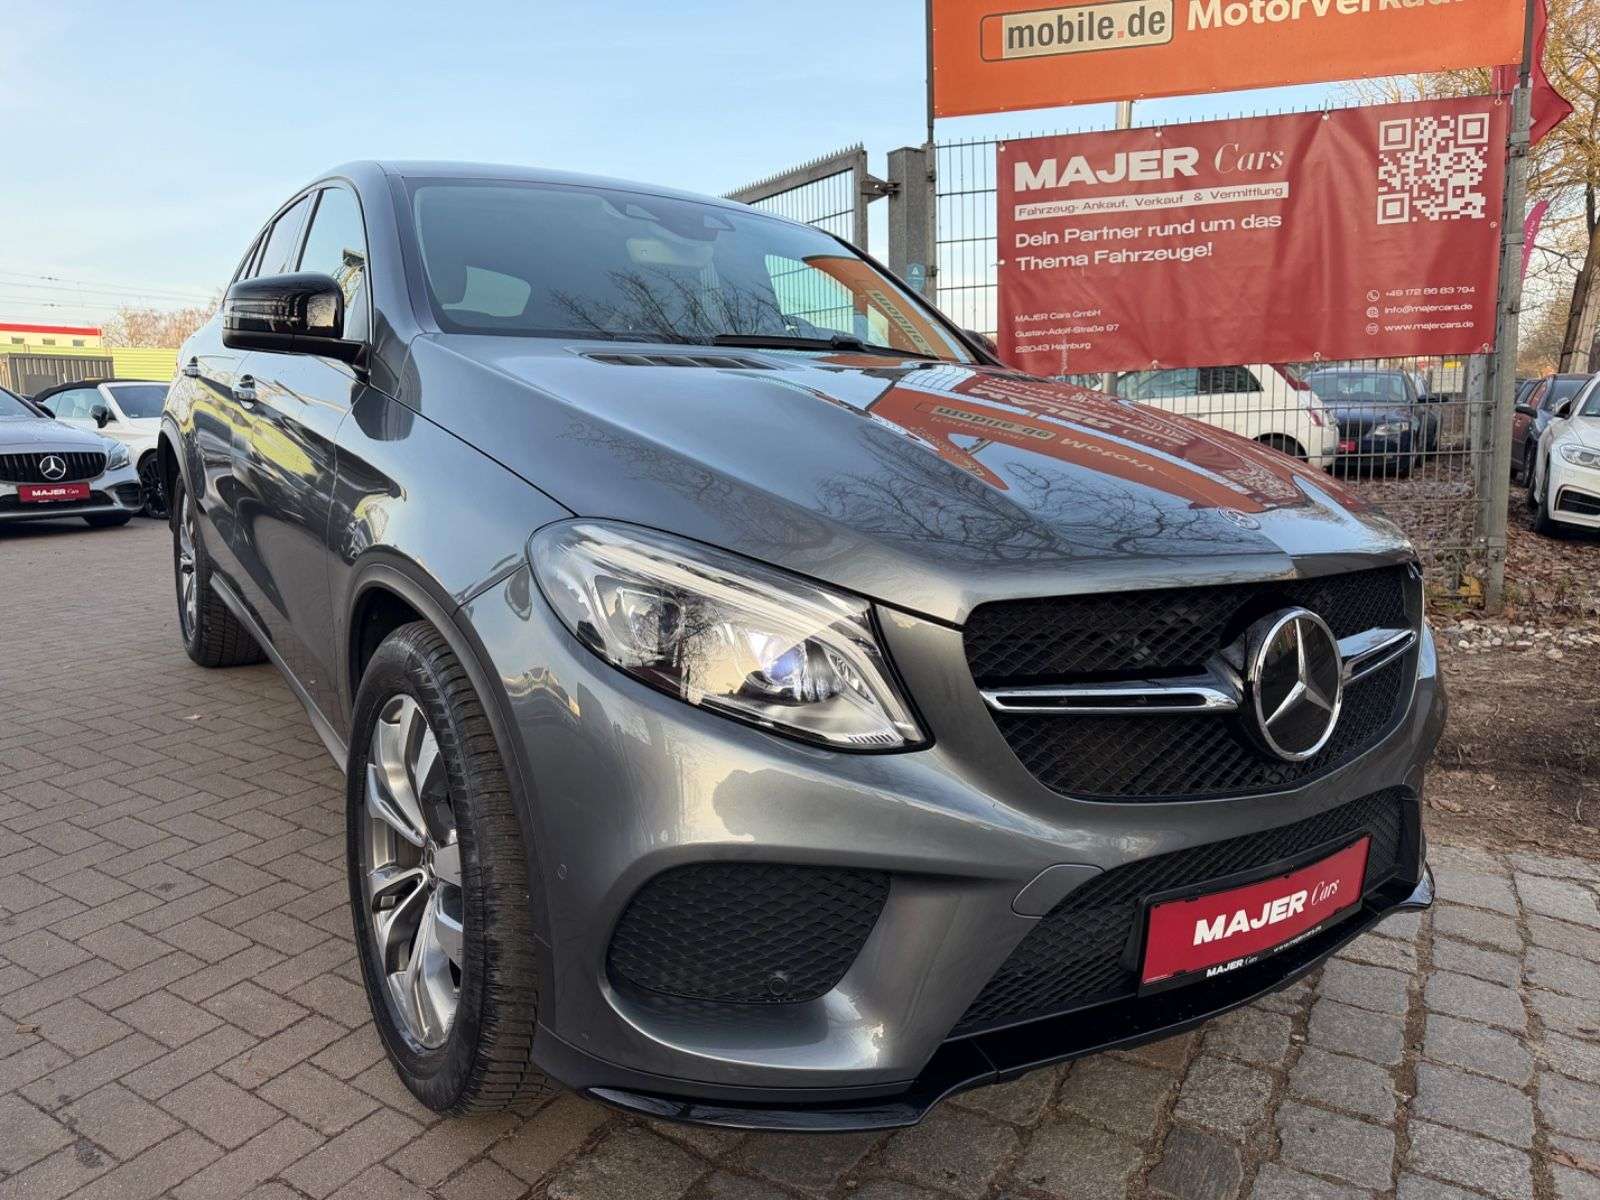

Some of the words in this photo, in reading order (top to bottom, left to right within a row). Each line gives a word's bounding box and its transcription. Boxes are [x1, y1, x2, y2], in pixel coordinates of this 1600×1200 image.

[1007, 2, 1167, 50] mobile.de
[1014, 146, 1200, 193] MAJER
[1214, 143, 1284, 175] Cars
[1135, 194, 1184, 207] Verkauf
[1193, 192, 1203, 201] &
[1210, 186, 1283, 200] Vermittlung
[1015, 230, 1059, 248] Dein
[1064, 225, 1142, 244] Partner
[1147, 218, 1197, 239] rund
[1200, 218, 1236, 233] um
[1241, 213, 1283, 230] das
[1015, 252, 1089, 272] Thema
[1094, 241, 1213, 266] Fahrzeuge!
[1014, 312, 1048, 322] MAJER
[1049, 311, 1071, 320] Cars
[1072, 309, 1102, 319] GmbH
[1384, 303, 1473, 315] info@majercars.de
[1384, 320, 1474, 332] www.majercars.de
[1051, 341, 1092, 351] Hamburg
[31, 488, 67, 497] MAJER
[1192, 889, 1309, 946] MAJER
[1311, 879, 1340, 906] Cars
[1206, 958, 1245, 978] MAJER
